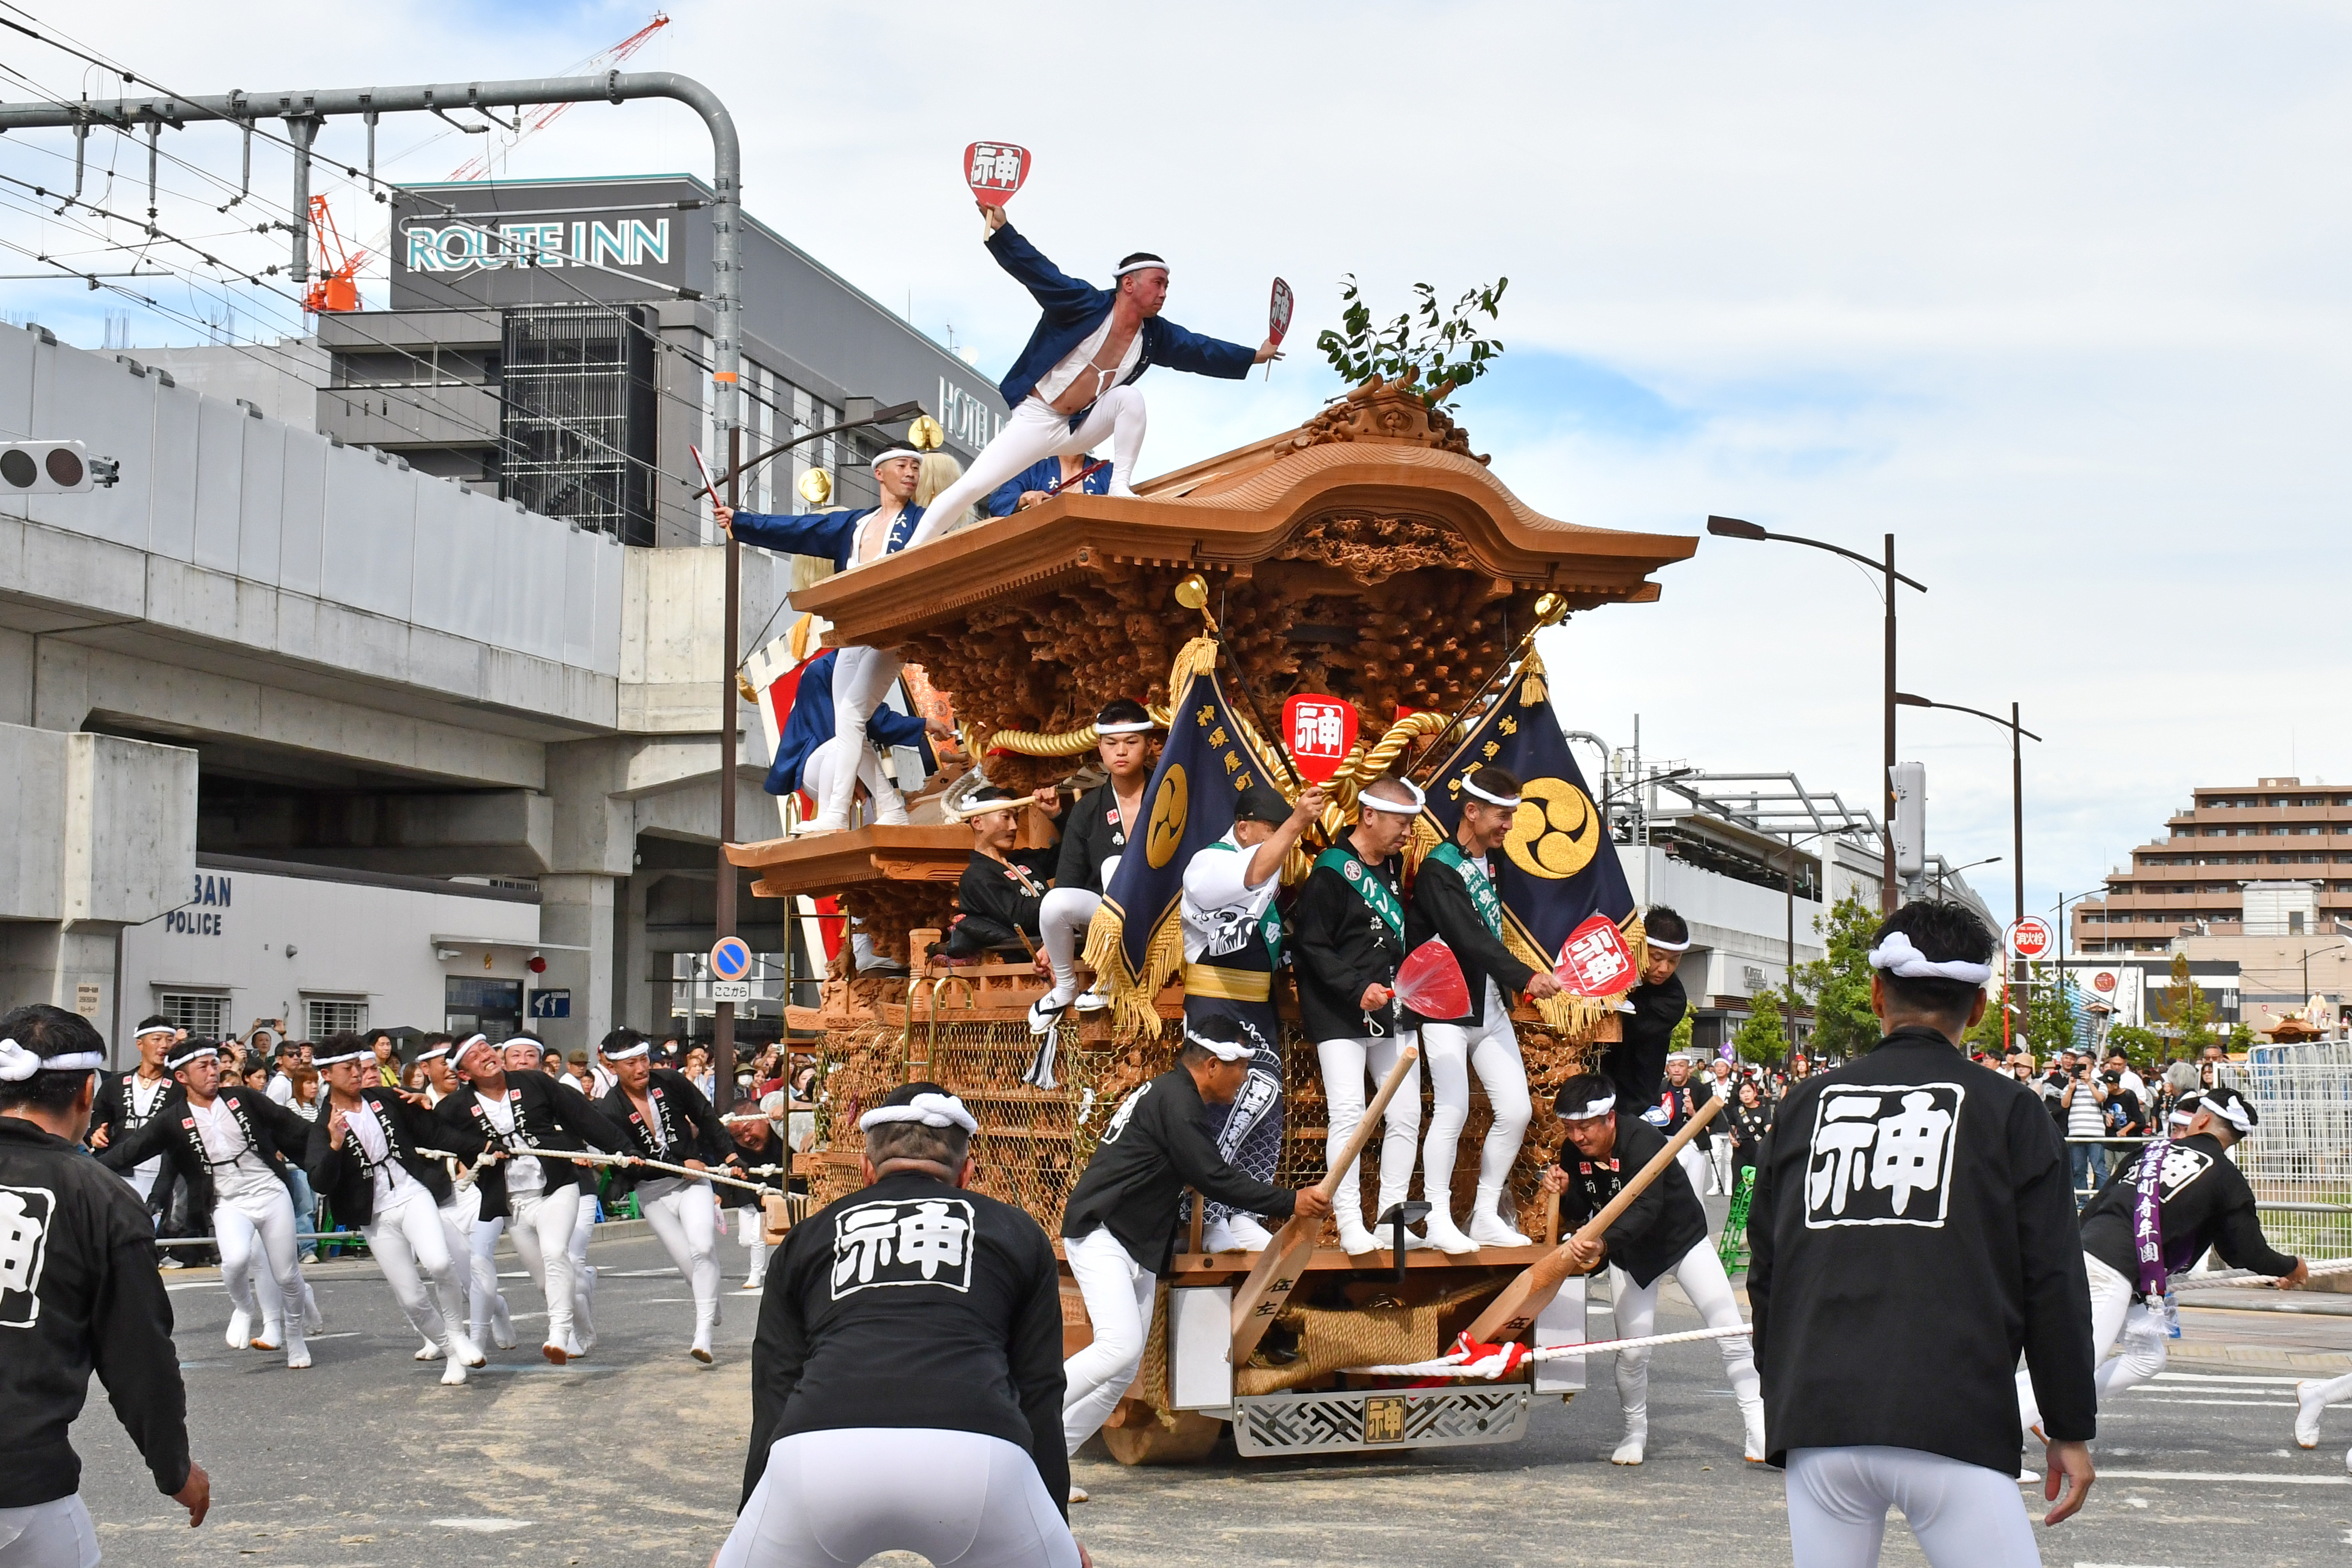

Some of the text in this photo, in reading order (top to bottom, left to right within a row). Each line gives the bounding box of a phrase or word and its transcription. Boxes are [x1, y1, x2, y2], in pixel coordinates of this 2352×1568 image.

[973, 147, 1019, 188] 神
[407, 218, 669, 272] ROUTE INN
[1271, 284, 1290, 331] 神
[939, 375, 987, 453] HOTEL
[1297, 707, 1342, 753] 神
[166, 911, 222, 936] POLICE
[2016, 932, 2045, 945] 消火栓
[715, 985, 747, 997] ここから
[659, 1101, 678, 1144] 三十人組
[346, 1135, 374, 1180] 三十人組
[1810, 1091, 1952, 1216] 神
[836, 1202, 969, 1287] 神
[1369, 1400, 1404, 1441] 神
